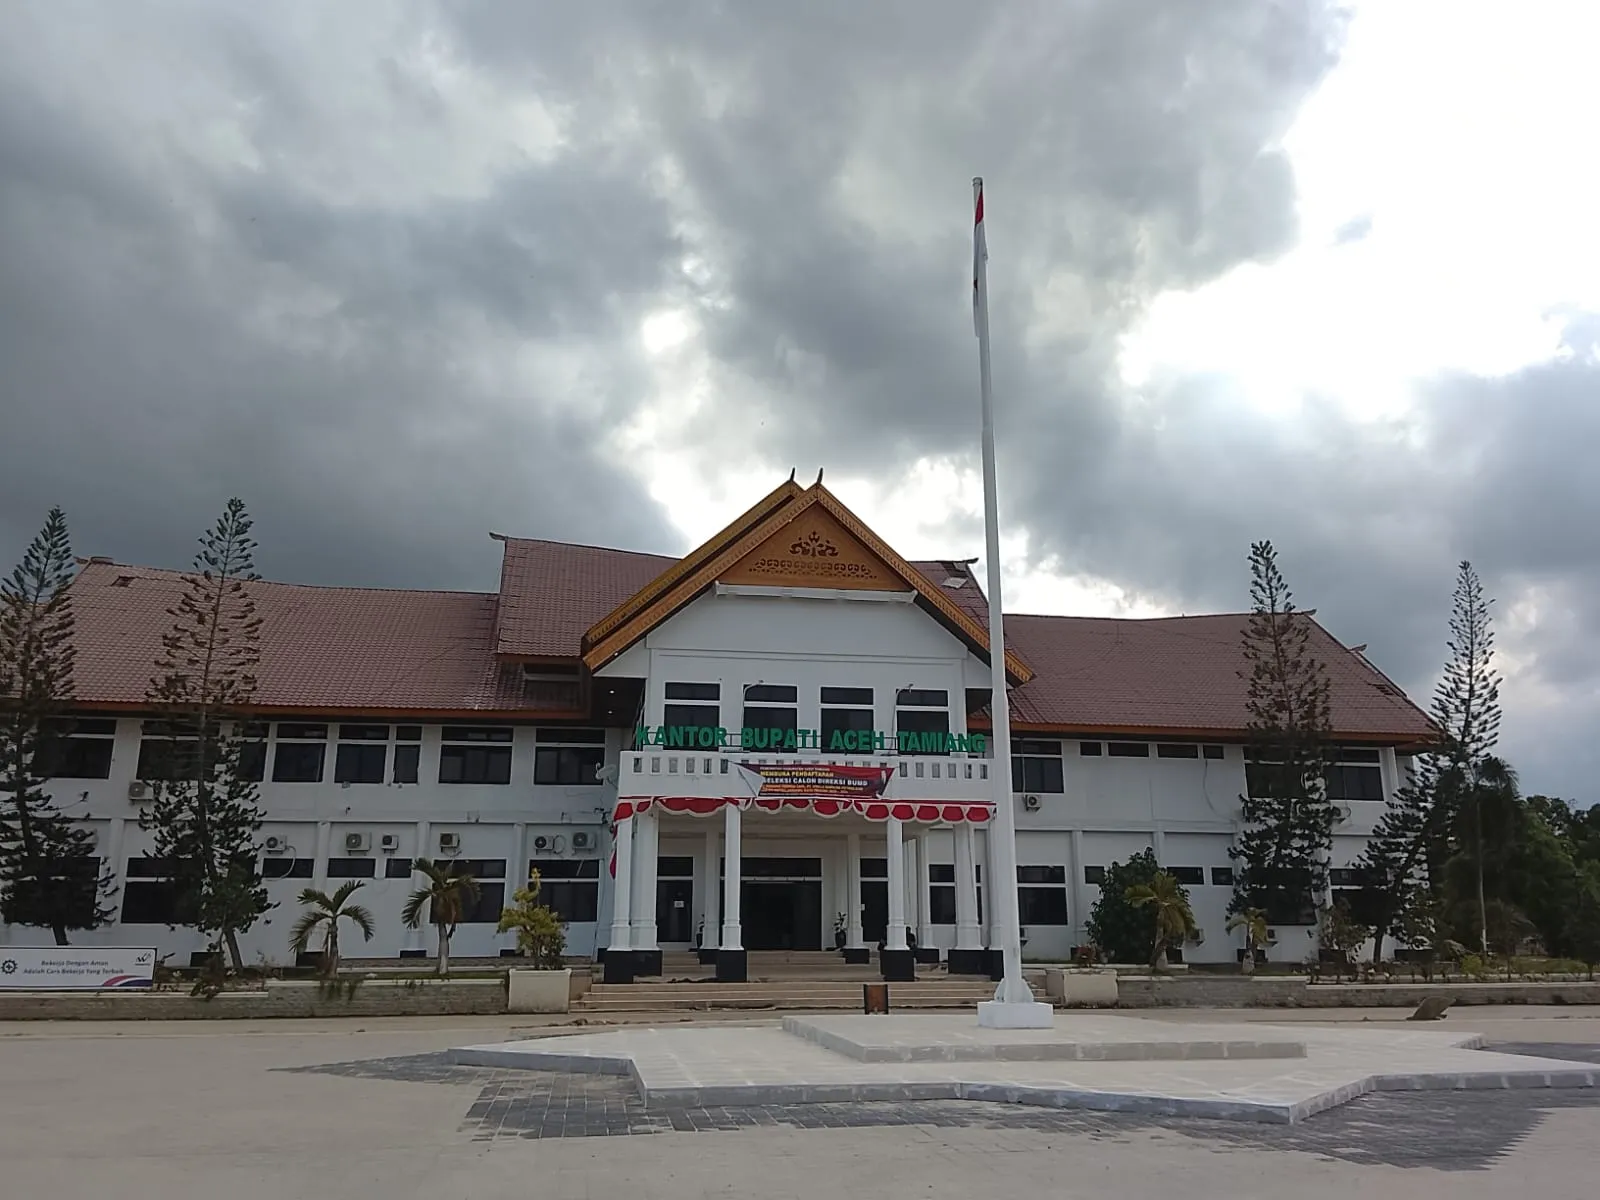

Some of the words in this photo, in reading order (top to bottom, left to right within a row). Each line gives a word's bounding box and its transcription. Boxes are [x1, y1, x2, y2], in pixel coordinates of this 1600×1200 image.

[635, 725, 728, 747] KANTOR
[740, 727, 817, 749] BUPATI
[830, 729, 885, 750] ACEH
[896, 731, 986, 753] TAMIANG
